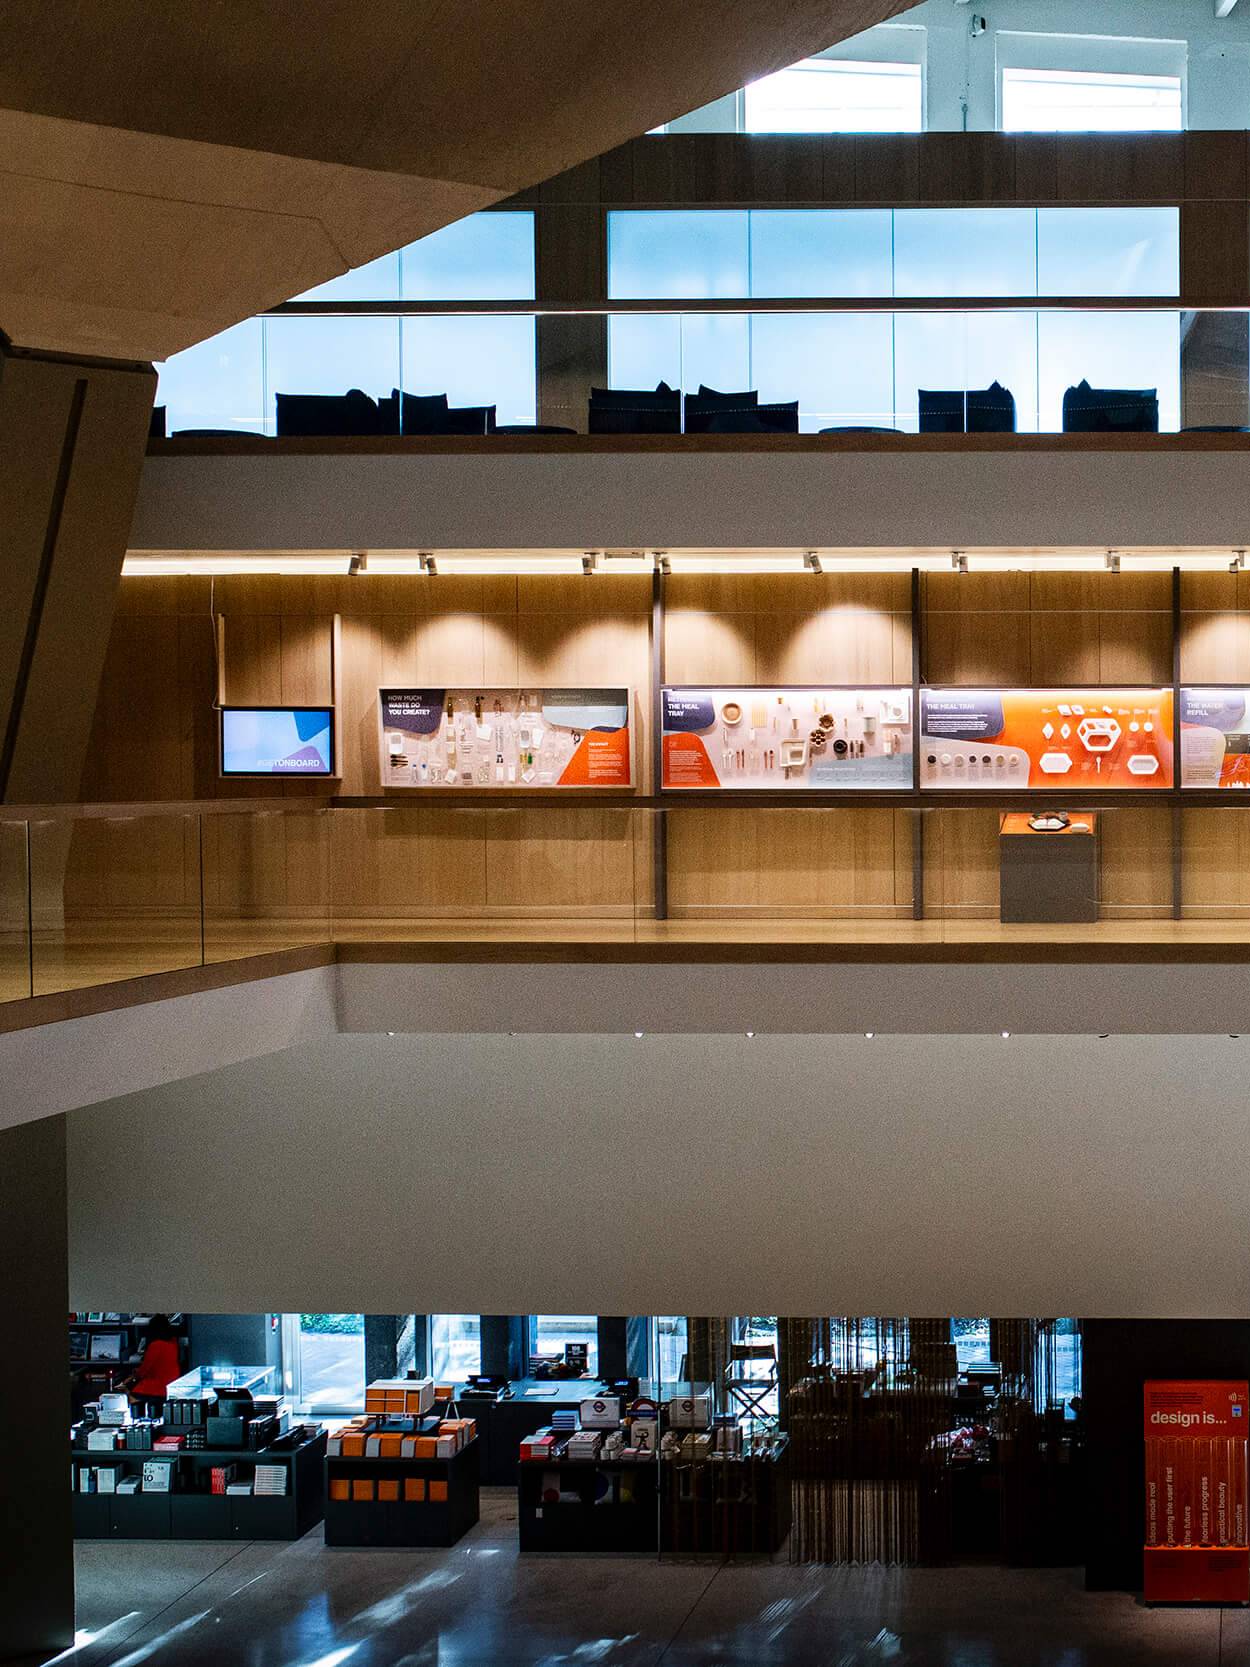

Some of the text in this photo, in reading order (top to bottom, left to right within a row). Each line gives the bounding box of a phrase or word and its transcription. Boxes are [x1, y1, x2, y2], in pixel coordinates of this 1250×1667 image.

[1150, 1410, 1227, 1427] design is...
[1148, 1481, 1157, 1497] real
[1149, 1498, 1157, 1520] made
[1165, 1467, 1176, 1543] putting the user first
[1200, 1476, 1210, 1543] fearless progress
[1218, 1482, 1227, 1543] practical beauty
[1234, 1503, 1243, 1543] innovative
